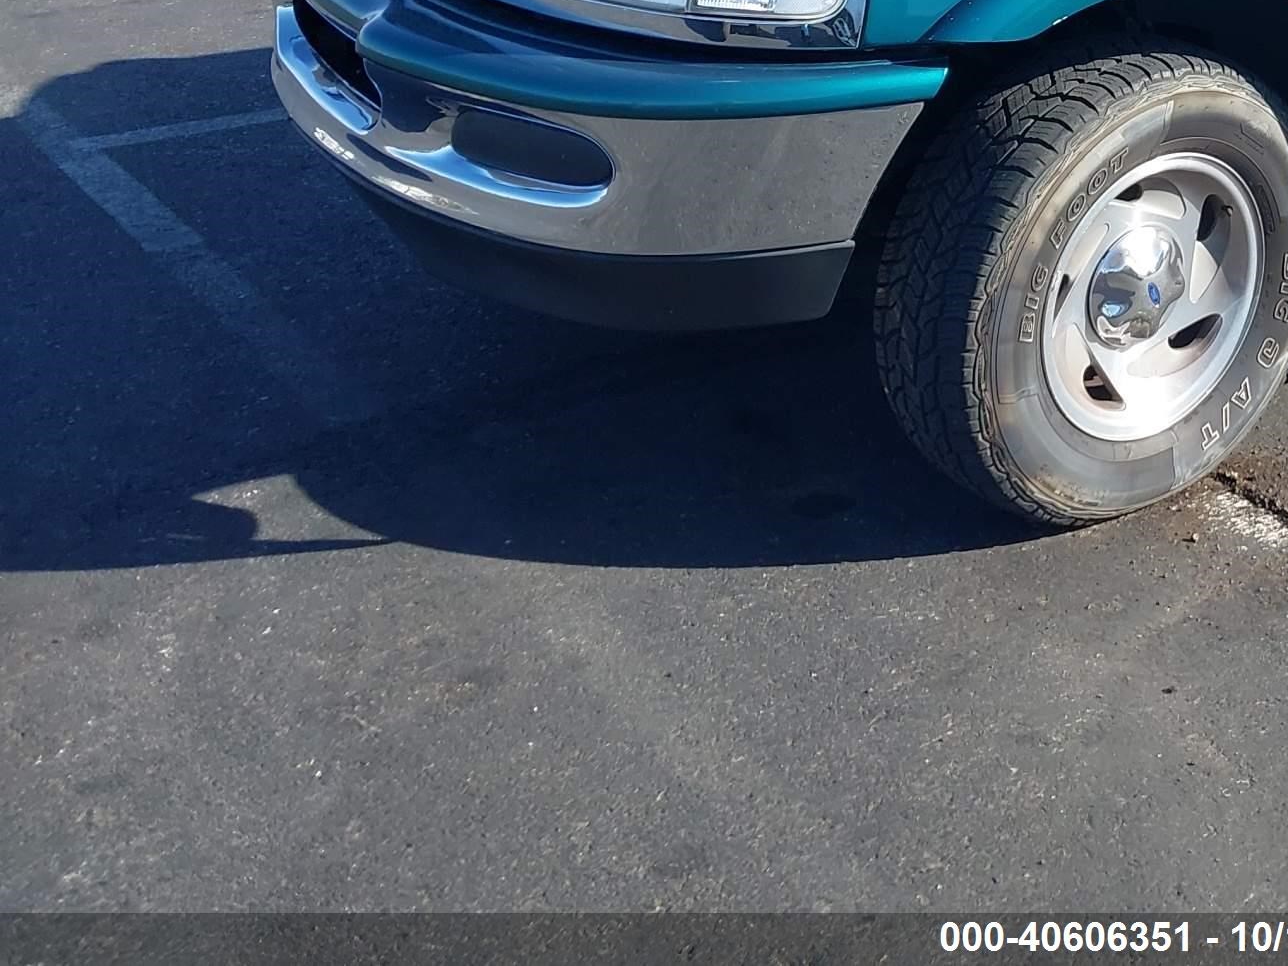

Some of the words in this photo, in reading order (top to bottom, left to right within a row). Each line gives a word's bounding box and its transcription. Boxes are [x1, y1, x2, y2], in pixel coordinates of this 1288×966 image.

[1018, 263, 1049, 343] BIG
[1049, 146, 1130, 250] FOOT
[1201, 376, 1253, 452] A/T
